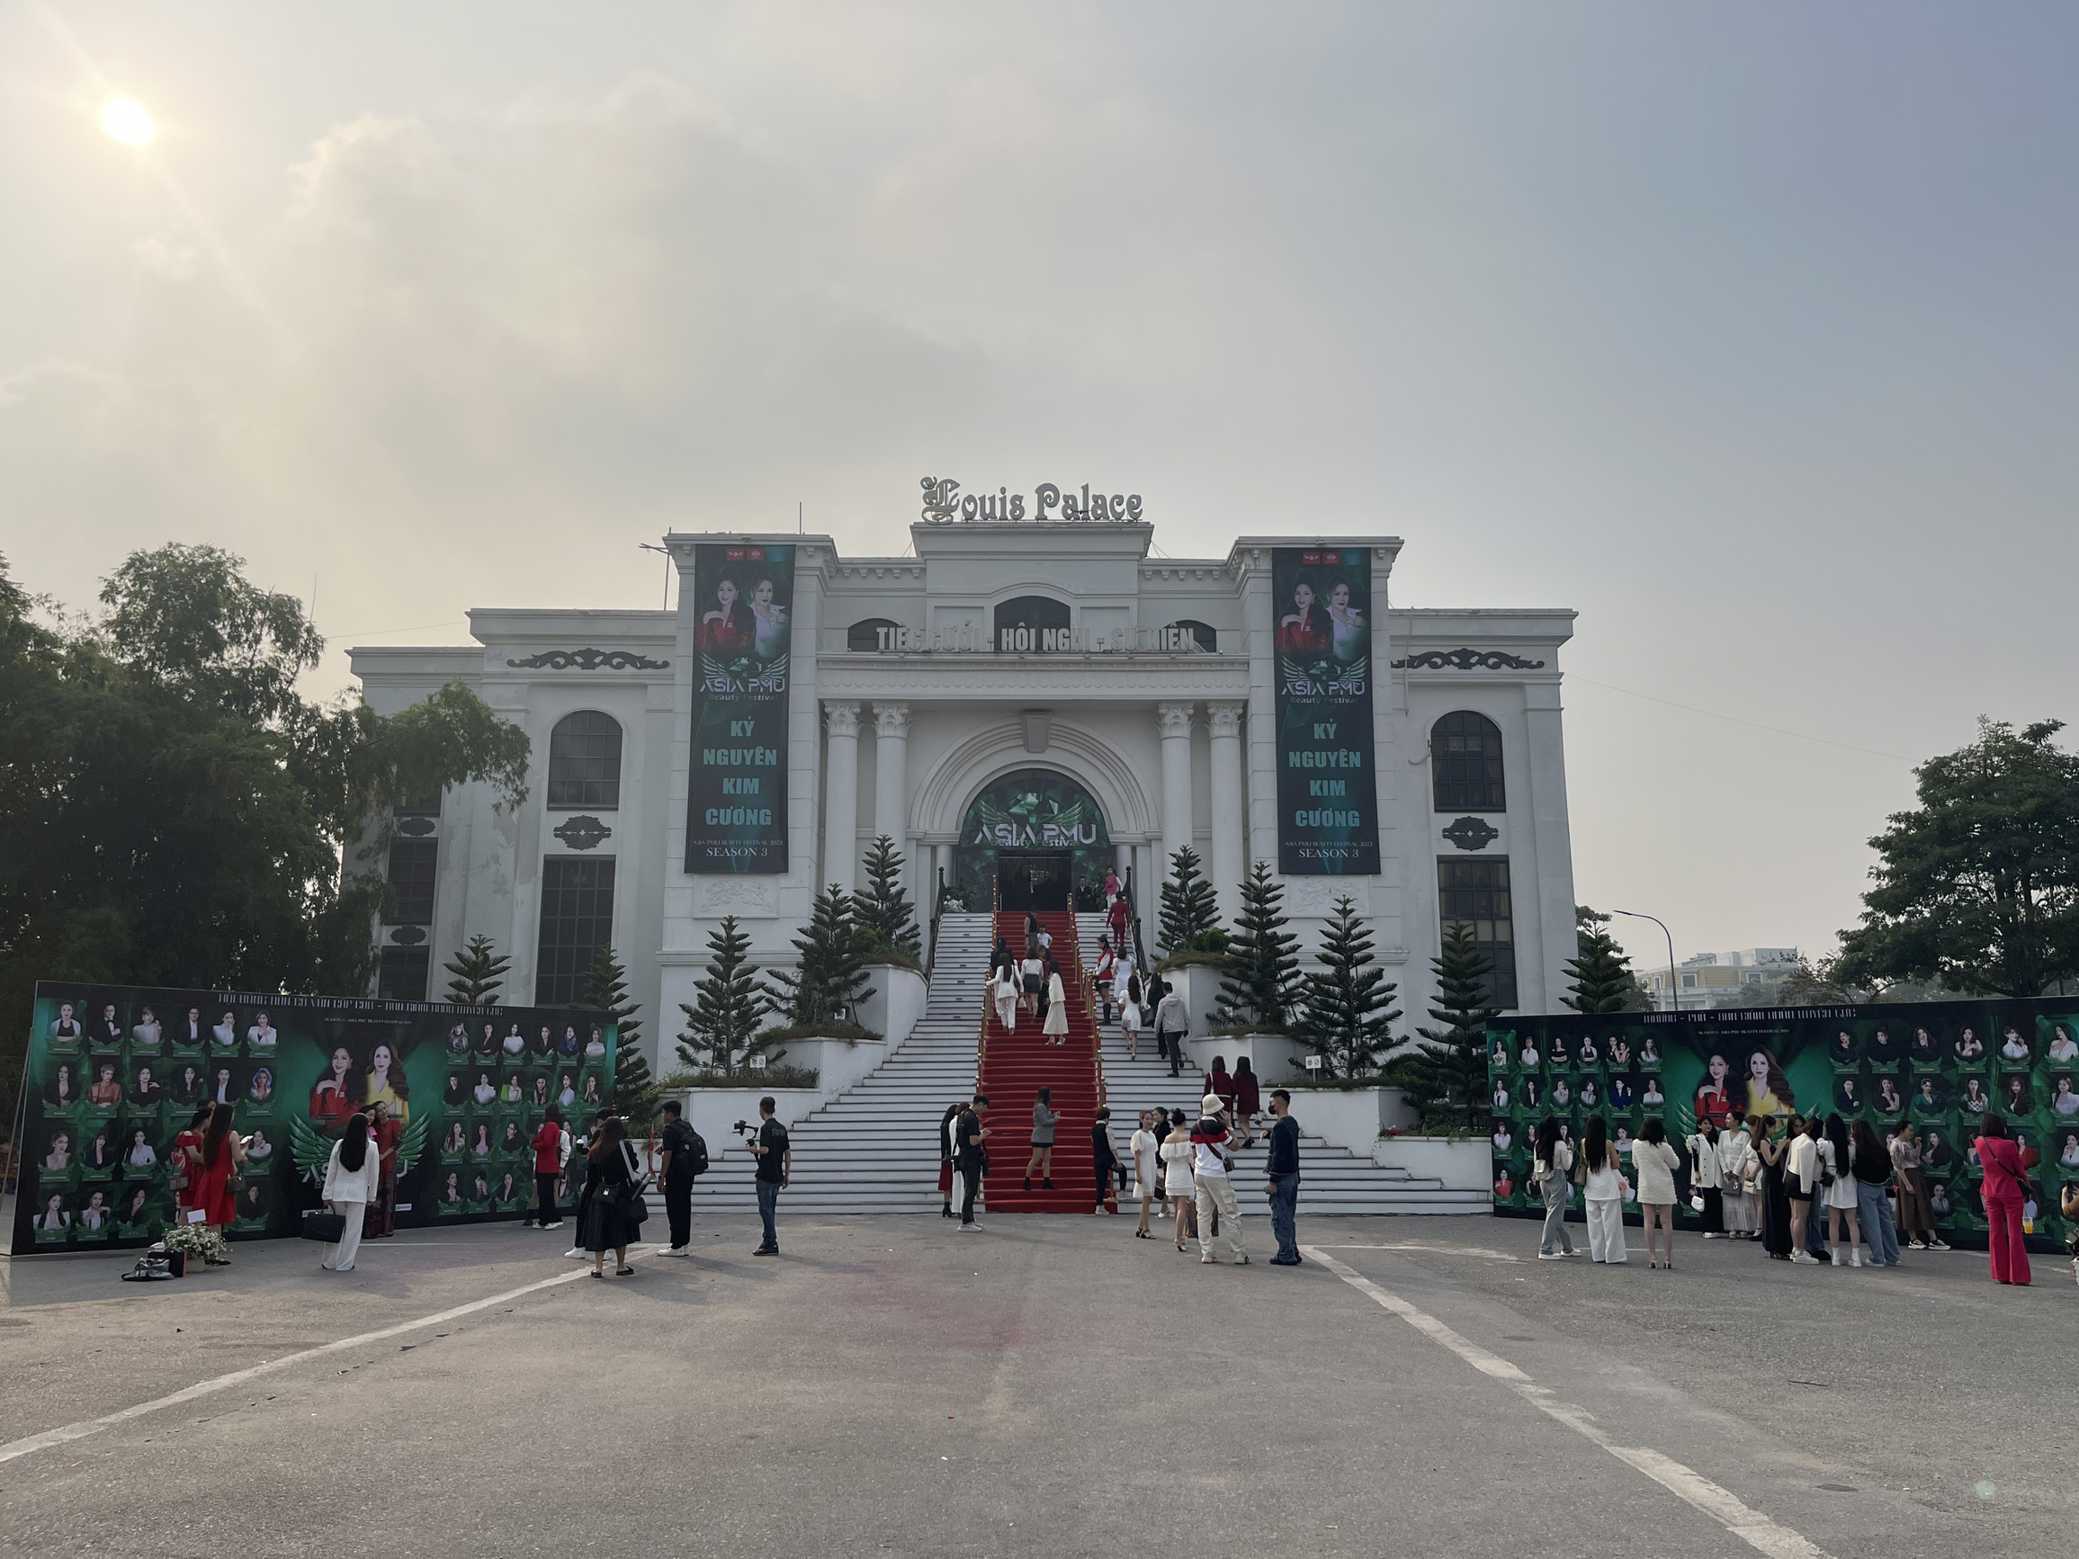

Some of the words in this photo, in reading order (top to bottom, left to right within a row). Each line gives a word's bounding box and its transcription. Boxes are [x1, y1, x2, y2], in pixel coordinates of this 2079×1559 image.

[920, 476, 1025, 525] Louis
[1034, 483, 1143, 521] Palace
[700, 678, 744, 692] ASIA
[748, 678, 785, 693] PMU
[1281, 682, 1326, 695] ASIA
[1328, 681, 1365, 696] PMU
[703, 746, 777, 766] NGUYÊN
[1288, 748, 1361, 768] NGUYÊN
[722, 777, 760, 794] KIM
[1310, 779, 1346, 797] KIM
[974, 823, 1036, 844] ASIA
[1043, 823, 1097, 844] PMU
[706, 848, 758, 857] SEASON
[1298, 848, 1348, 858] SEASON
